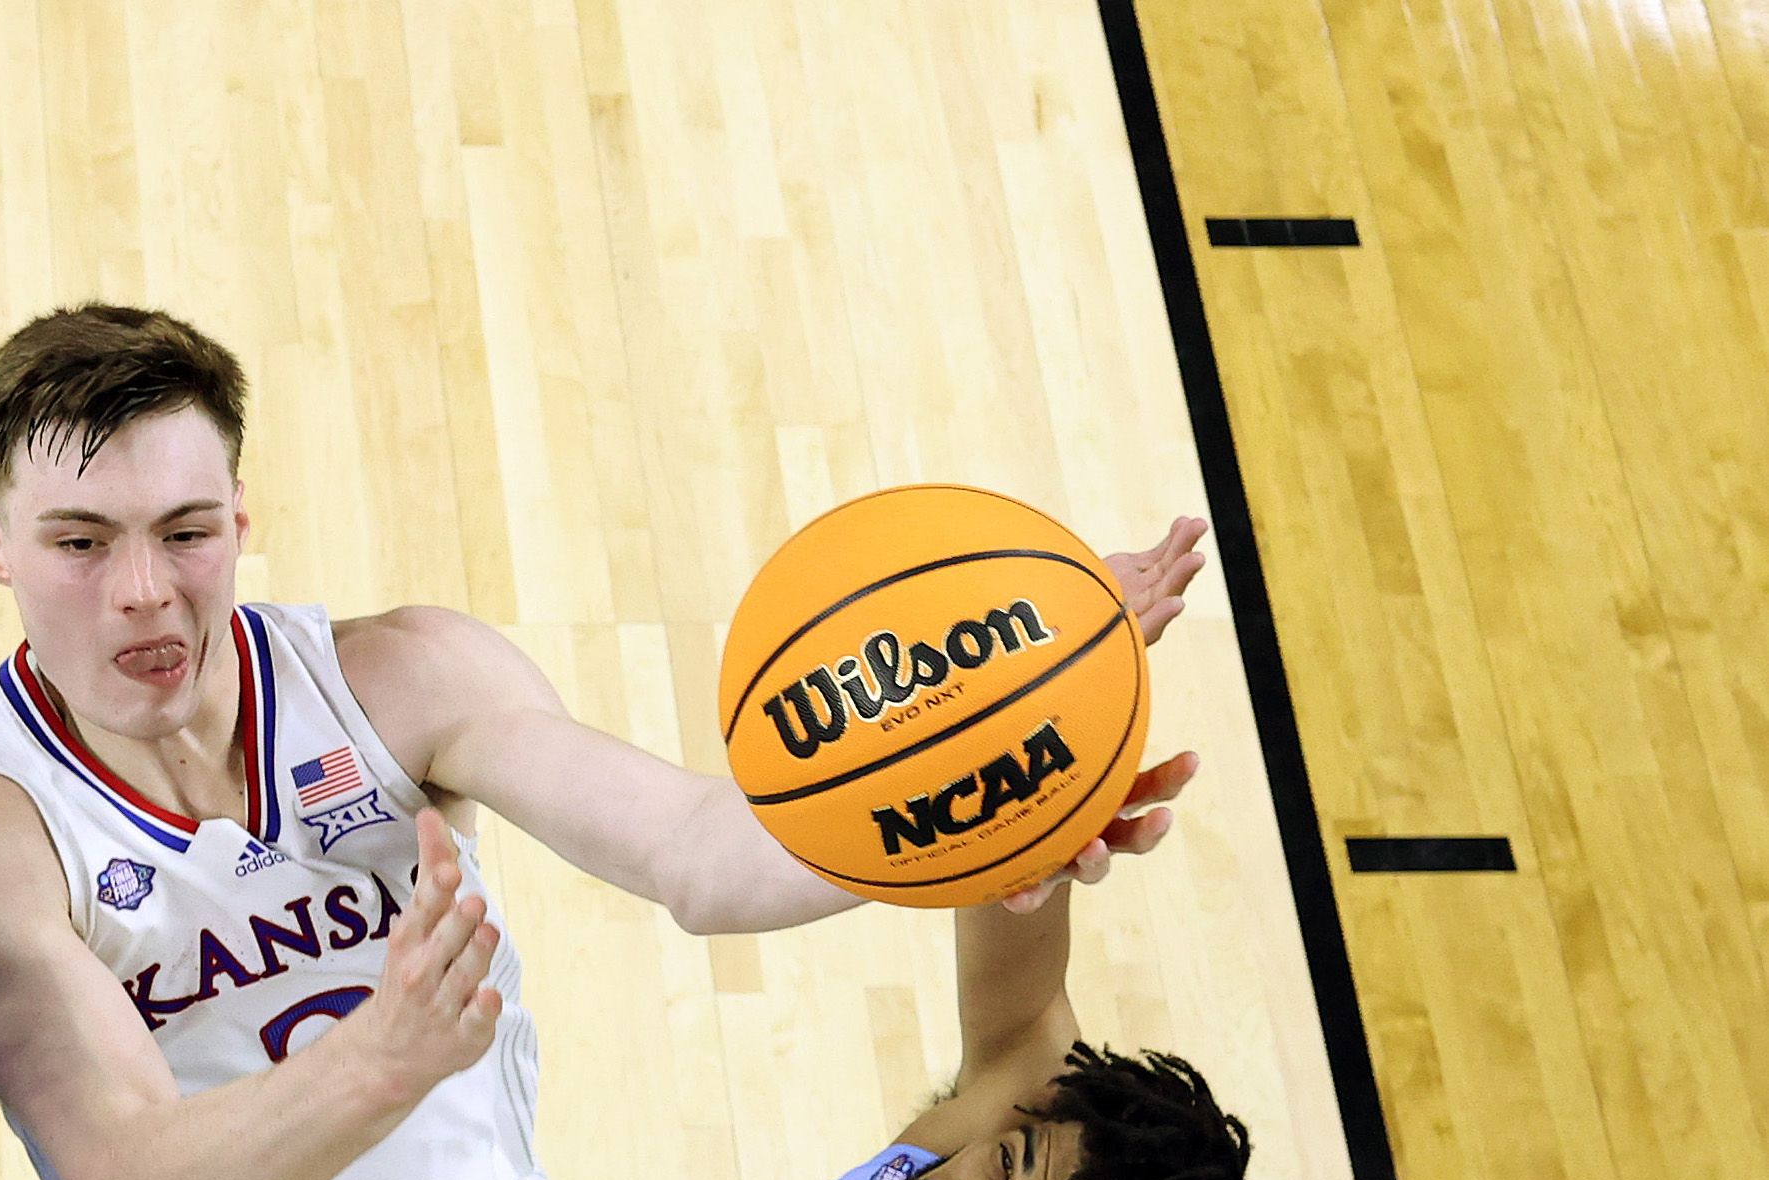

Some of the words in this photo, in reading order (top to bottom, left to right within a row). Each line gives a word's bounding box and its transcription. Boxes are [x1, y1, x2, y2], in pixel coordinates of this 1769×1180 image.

[762, 598, 1056, 760] Wilson
[880, 706, 920, 732] EVO
[924, 682, 964, 710] NXT
[871, 720, 1076, 857] NCAA
[108, 865, 136, 889] FINAL
[234, 850, 293, 878] adida
[112, 878, 139, 902] FOUR
[123, 862, 421, 1033] KANSA
